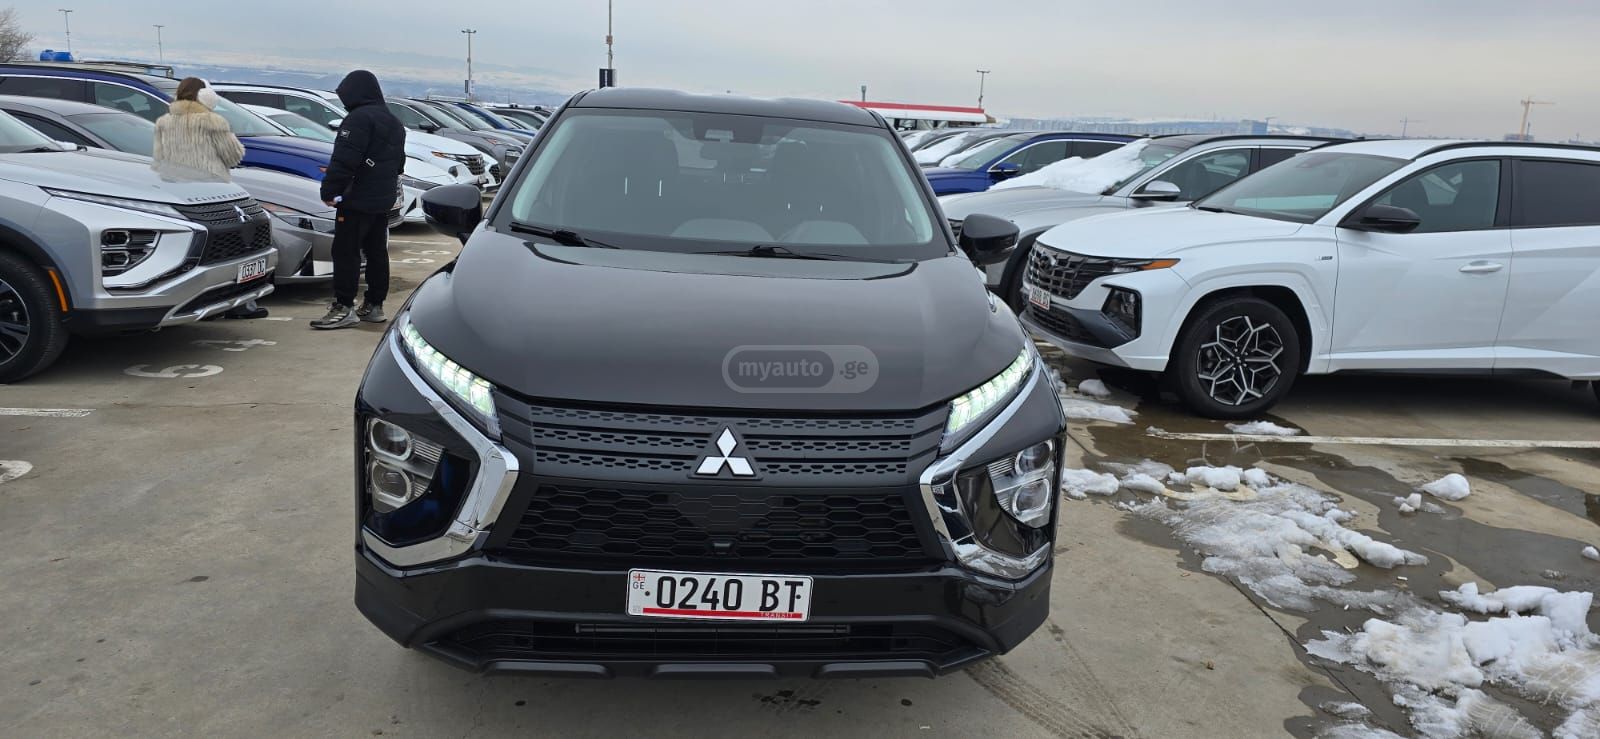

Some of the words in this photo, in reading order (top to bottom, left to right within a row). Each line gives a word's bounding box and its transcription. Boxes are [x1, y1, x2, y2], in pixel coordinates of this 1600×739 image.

[632, 581, 646, 590] GE
[656, 576, 743, 611] 0240
[759, 580, 804, 612] BT
